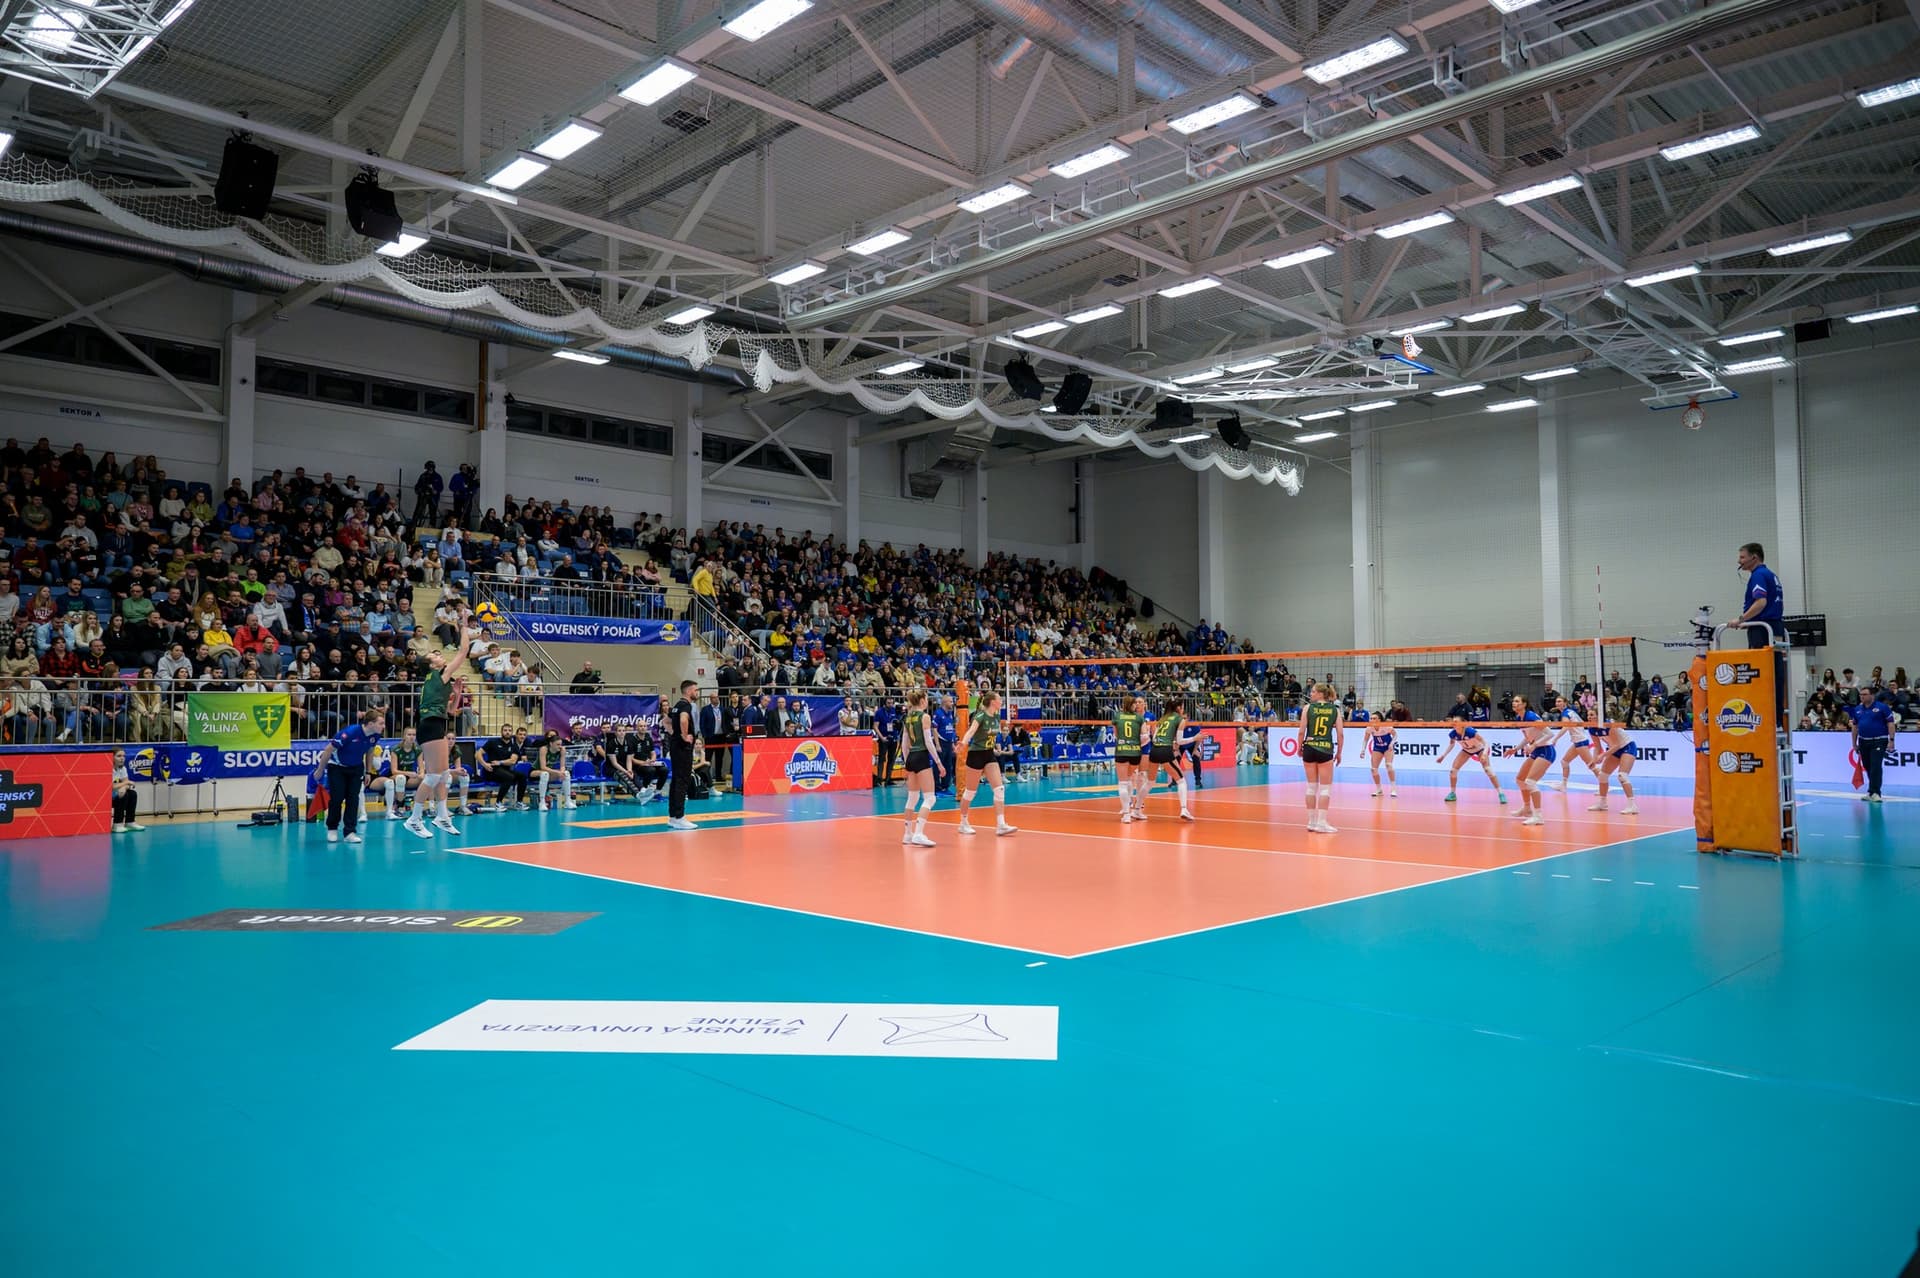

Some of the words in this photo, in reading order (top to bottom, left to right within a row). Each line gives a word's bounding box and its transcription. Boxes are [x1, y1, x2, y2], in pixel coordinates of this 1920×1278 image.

[531, 622, 600, 636] SLOVENSKÝ
[602, 624, 641, 637] POHÁR
[194, 711, 209, 721] VA
[212, 711, 247, 721] UNIZA
[202, 723, 239, 733] ŽILINA
[1124, 721, 1132, 738] 6
[1313, 716, 1329, 736] 15
[1393, 741, 1440, 756] ŠPORT
[223, 750, 325, 768] SLOVENSK
[238, 914, 447, 926] Slovnaft
[482, 1024, 653, 1033] UNIVERZITA
[786, 1018, 806, 1026] V
